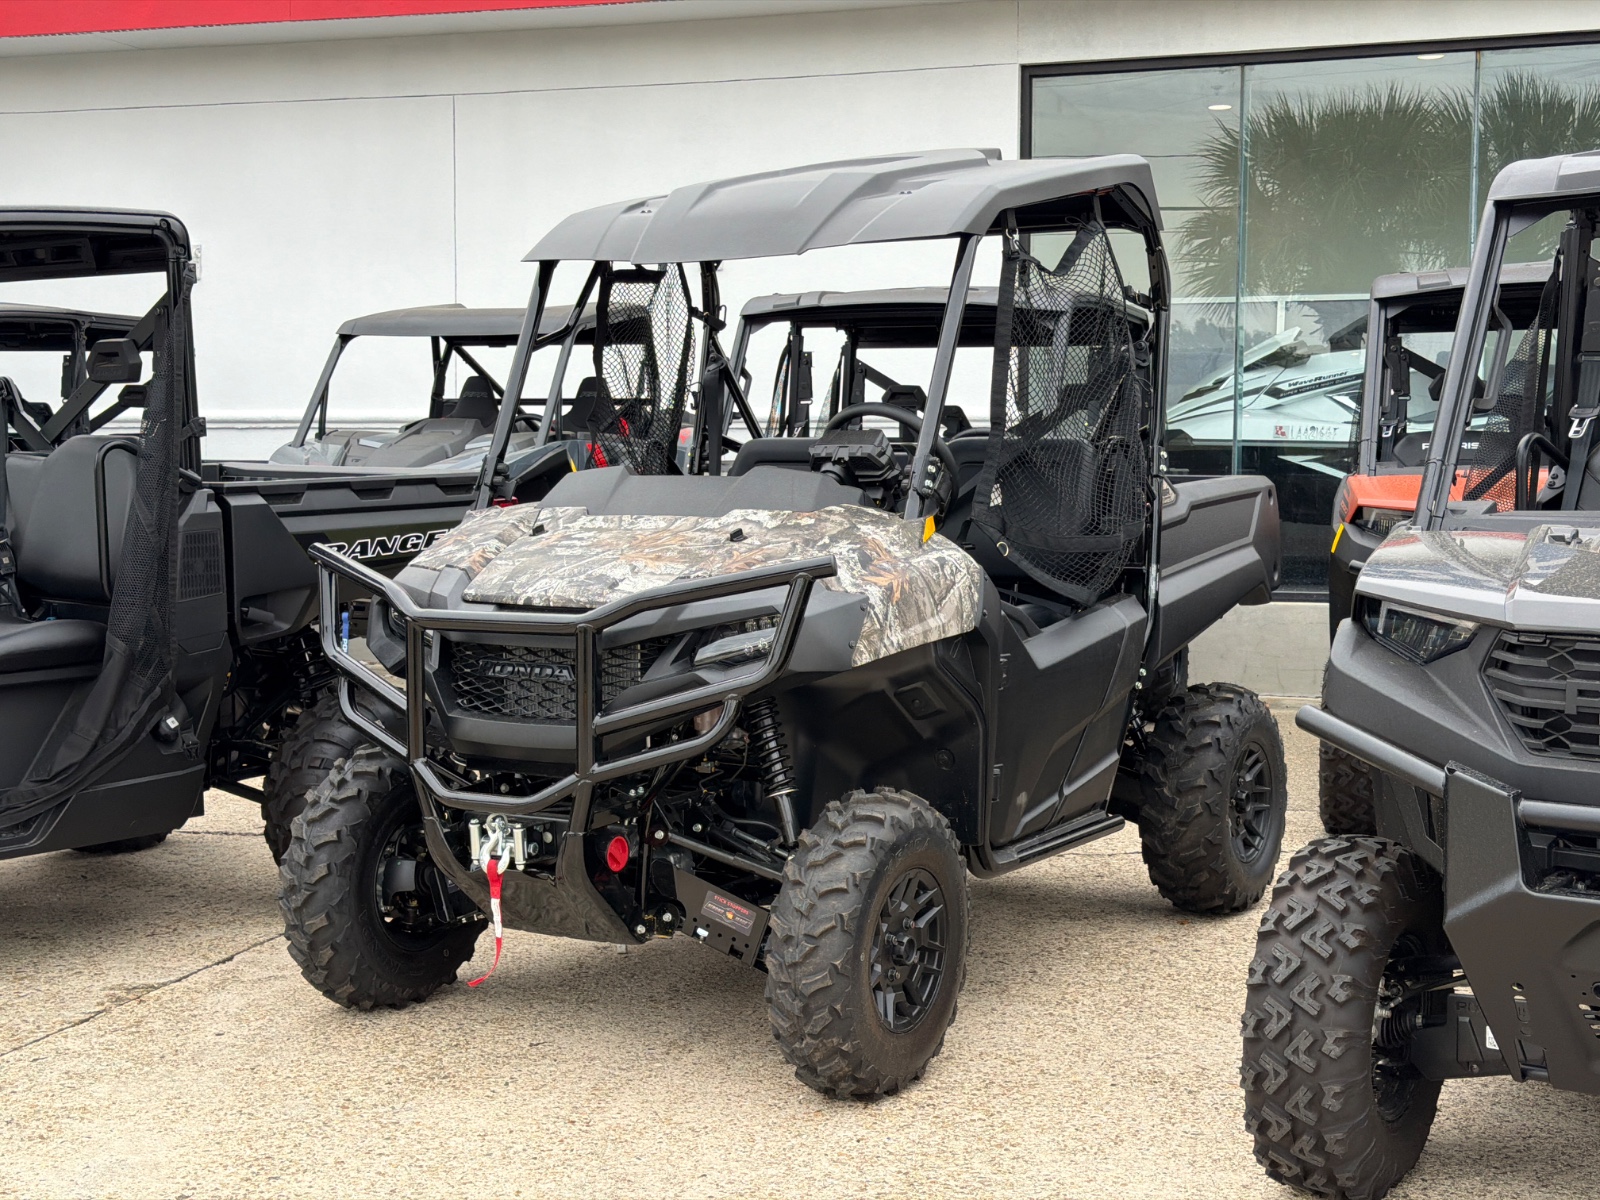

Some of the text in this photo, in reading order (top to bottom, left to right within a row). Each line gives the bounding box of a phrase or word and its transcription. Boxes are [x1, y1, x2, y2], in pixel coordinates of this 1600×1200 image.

[1288, 371, 1348, 387] WaveRunner
[1421, 442, 1480, 450] PRIS
[479, 660, 575, 682] HONDA
